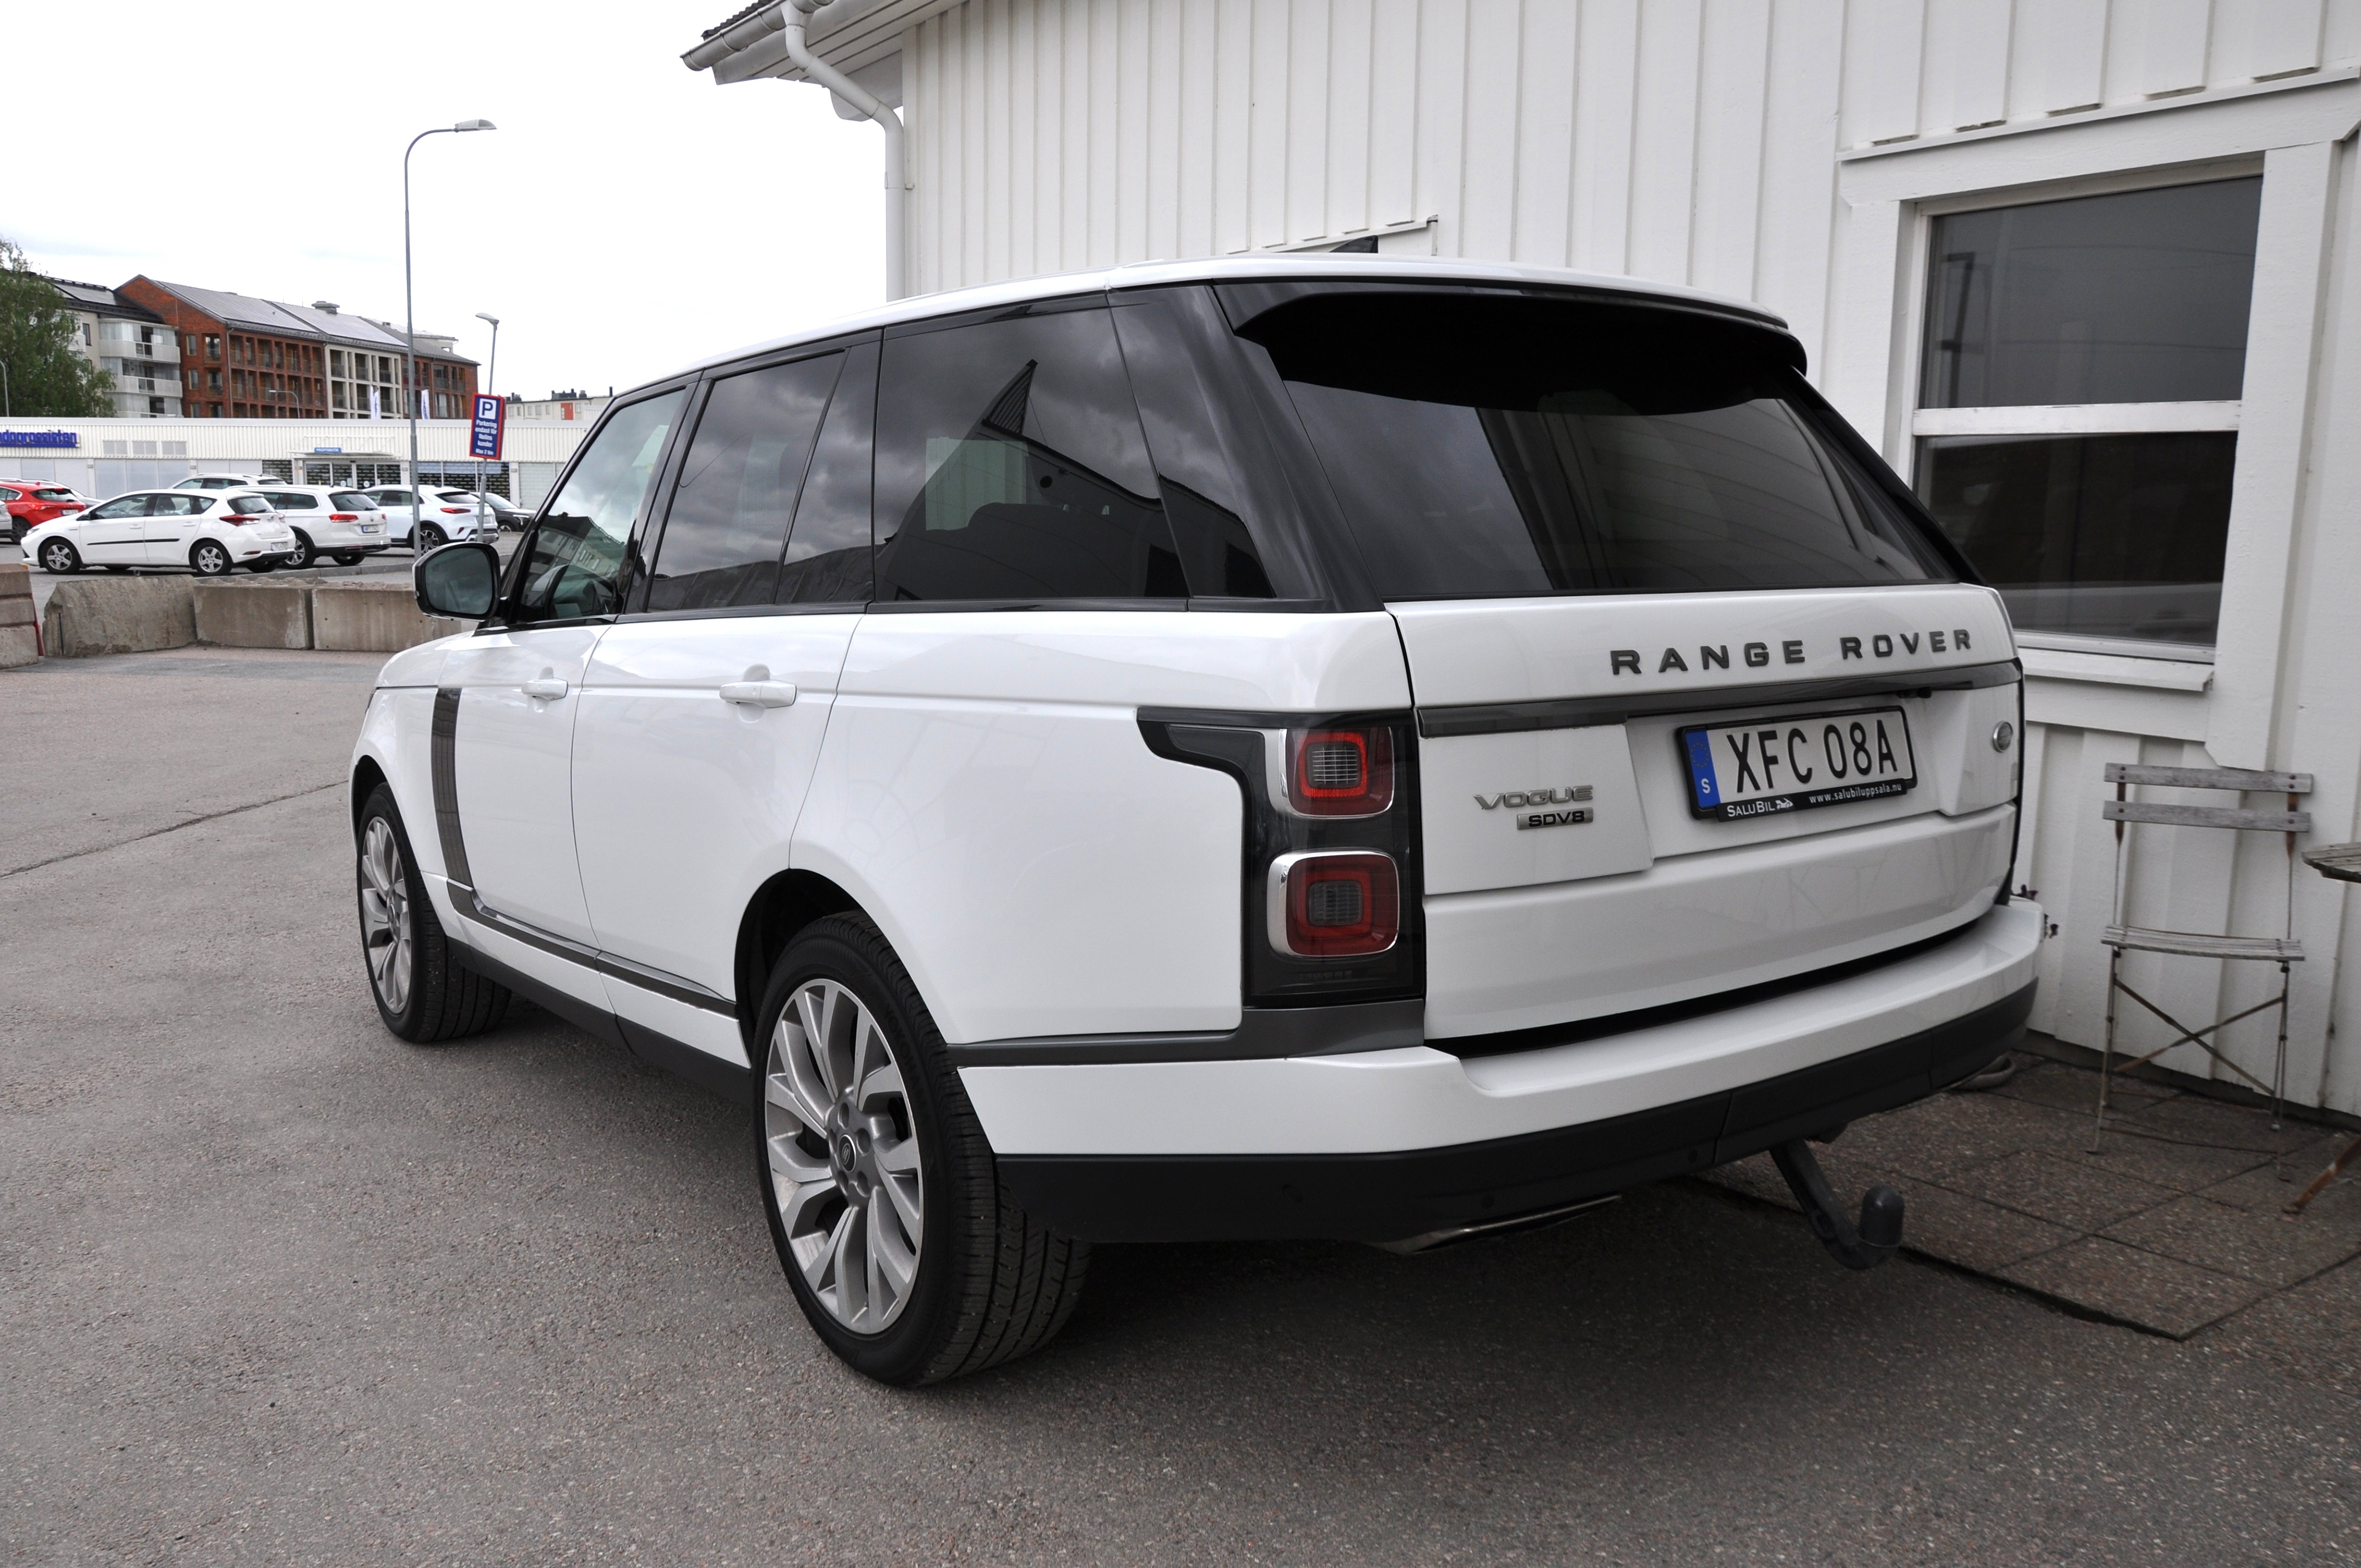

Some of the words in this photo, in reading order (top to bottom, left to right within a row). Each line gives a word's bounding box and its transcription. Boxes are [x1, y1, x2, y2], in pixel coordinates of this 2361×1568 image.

[482, 401, 493, 416] P
[476, 420, 497, 428] Parkering
[1610, 640, 1806, 676] RANGE
[1839, 629, 1972, 660] ROVER
[1726, 727, 1813, 793] XFC
[1823, 719, 1898, 779] 08A
[1701, 778, 1711, 794] S
[1809, 782, 1902, 804] www.salubiluppsala.nu
[1472, 784, 1594, 810] VOGUE
[1528, 810, 1585, 827] SDV8
